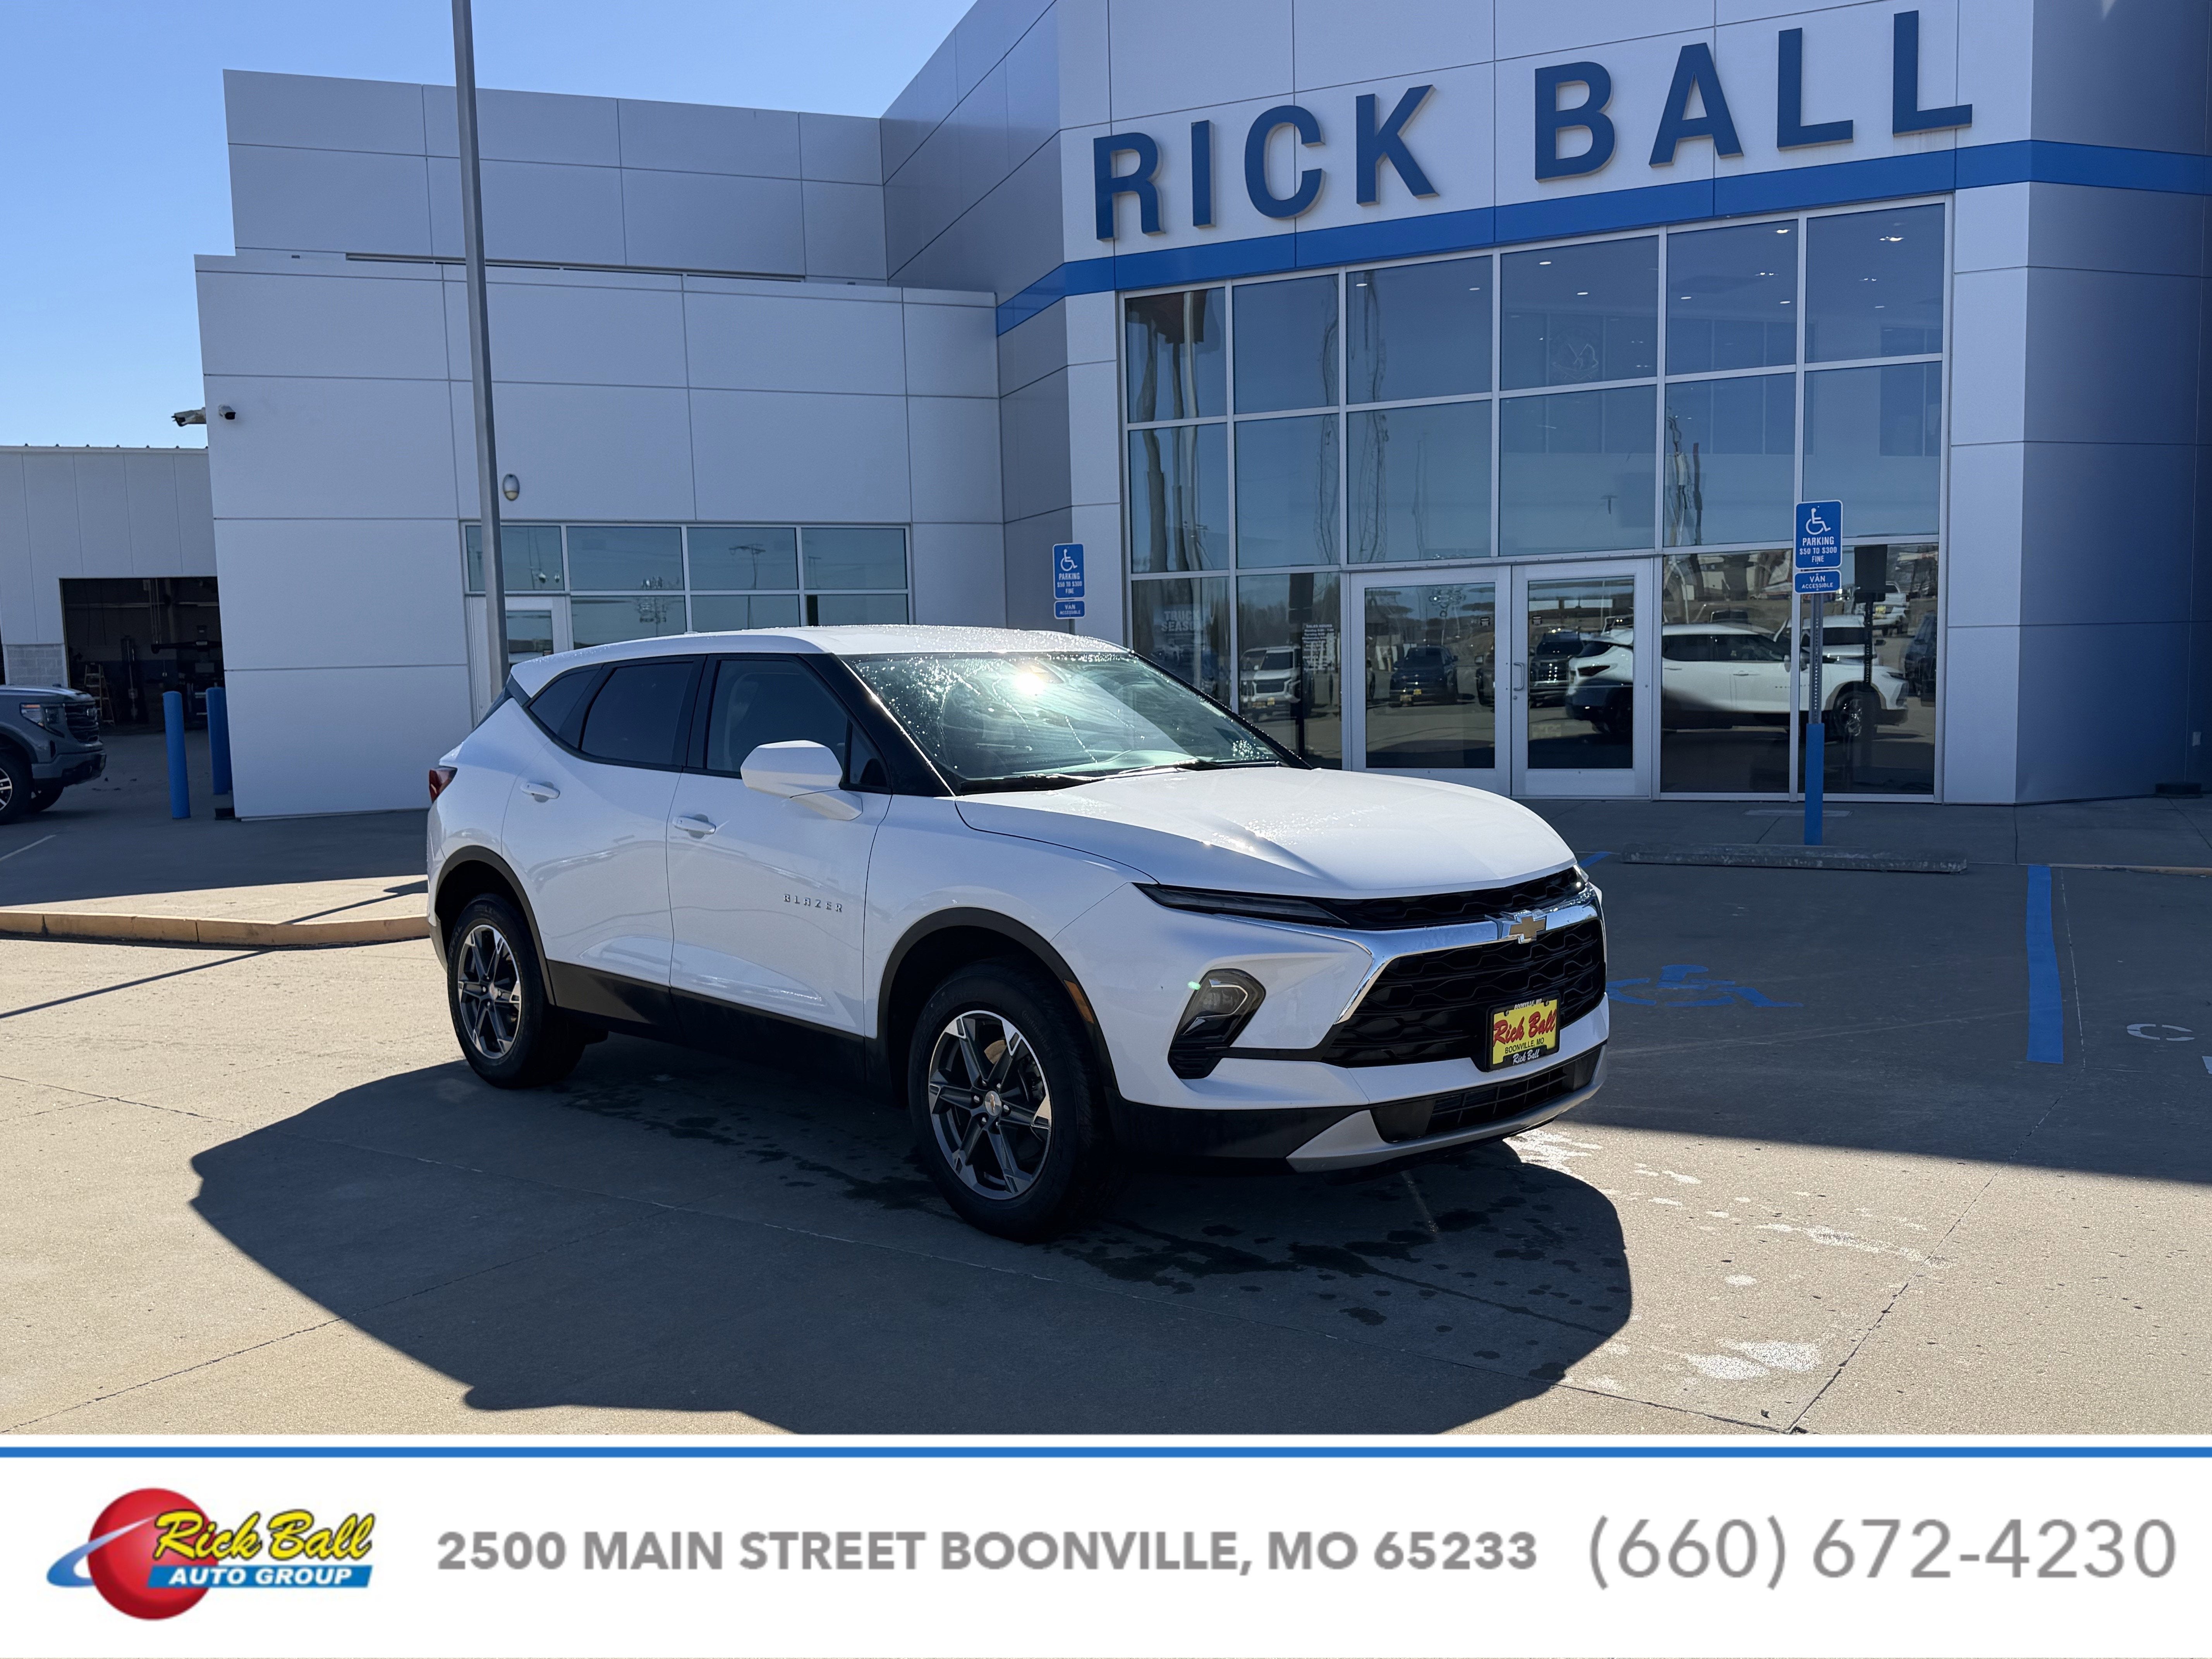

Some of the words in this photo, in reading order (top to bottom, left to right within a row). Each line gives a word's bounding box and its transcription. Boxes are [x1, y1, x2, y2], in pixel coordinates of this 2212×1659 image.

[1093, 84, 1439, 242] RICK
[1534, 10, 1973, 182] BALL
[1802, 536, 1834, 546] PARKING
[1059, 572, 1080, 580] PARKING
[783, 893, 842, 913] BLAZER
[1493, 1016, 1525, 1048] Rick
[1528, 1009, 1557, 1038] Ball
[1505, 1040, 1535, 1054] BOONVILLE,
[1513, 1051, 1526, 1065] Rick
[1527, 1048, 1540, 1060] Ball
